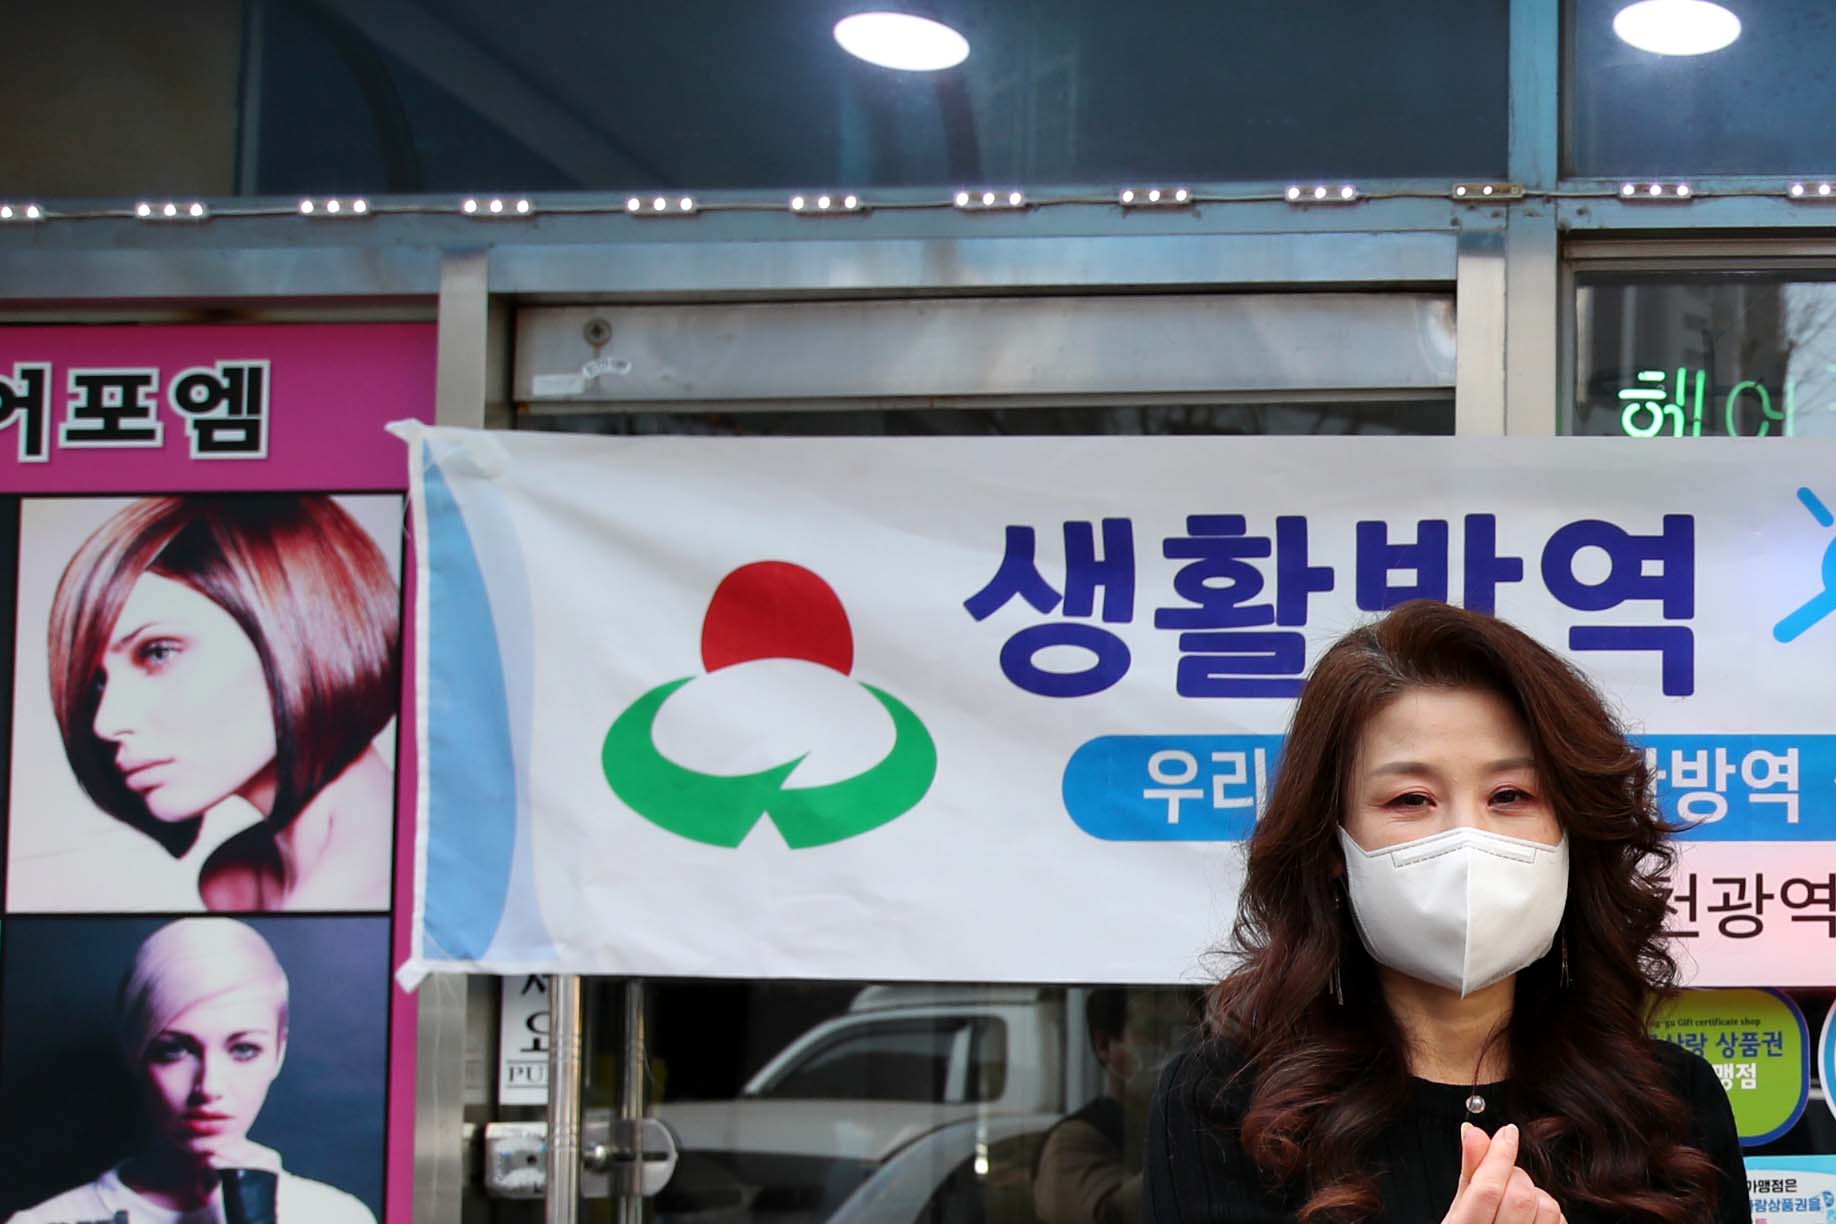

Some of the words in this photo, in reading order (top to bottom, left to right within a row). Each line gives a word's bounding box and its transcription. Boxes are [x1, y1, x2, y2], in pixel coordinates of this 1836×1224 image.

[1144, 748, 1267, 824] 우리
[1655, 747, 1800, 824] 방역
[1695, 1017, 1741, 1027] certificate
[1741, 1017, 1760, 1027] shop
[1716, 1031, 1783, 1058] 상품권
